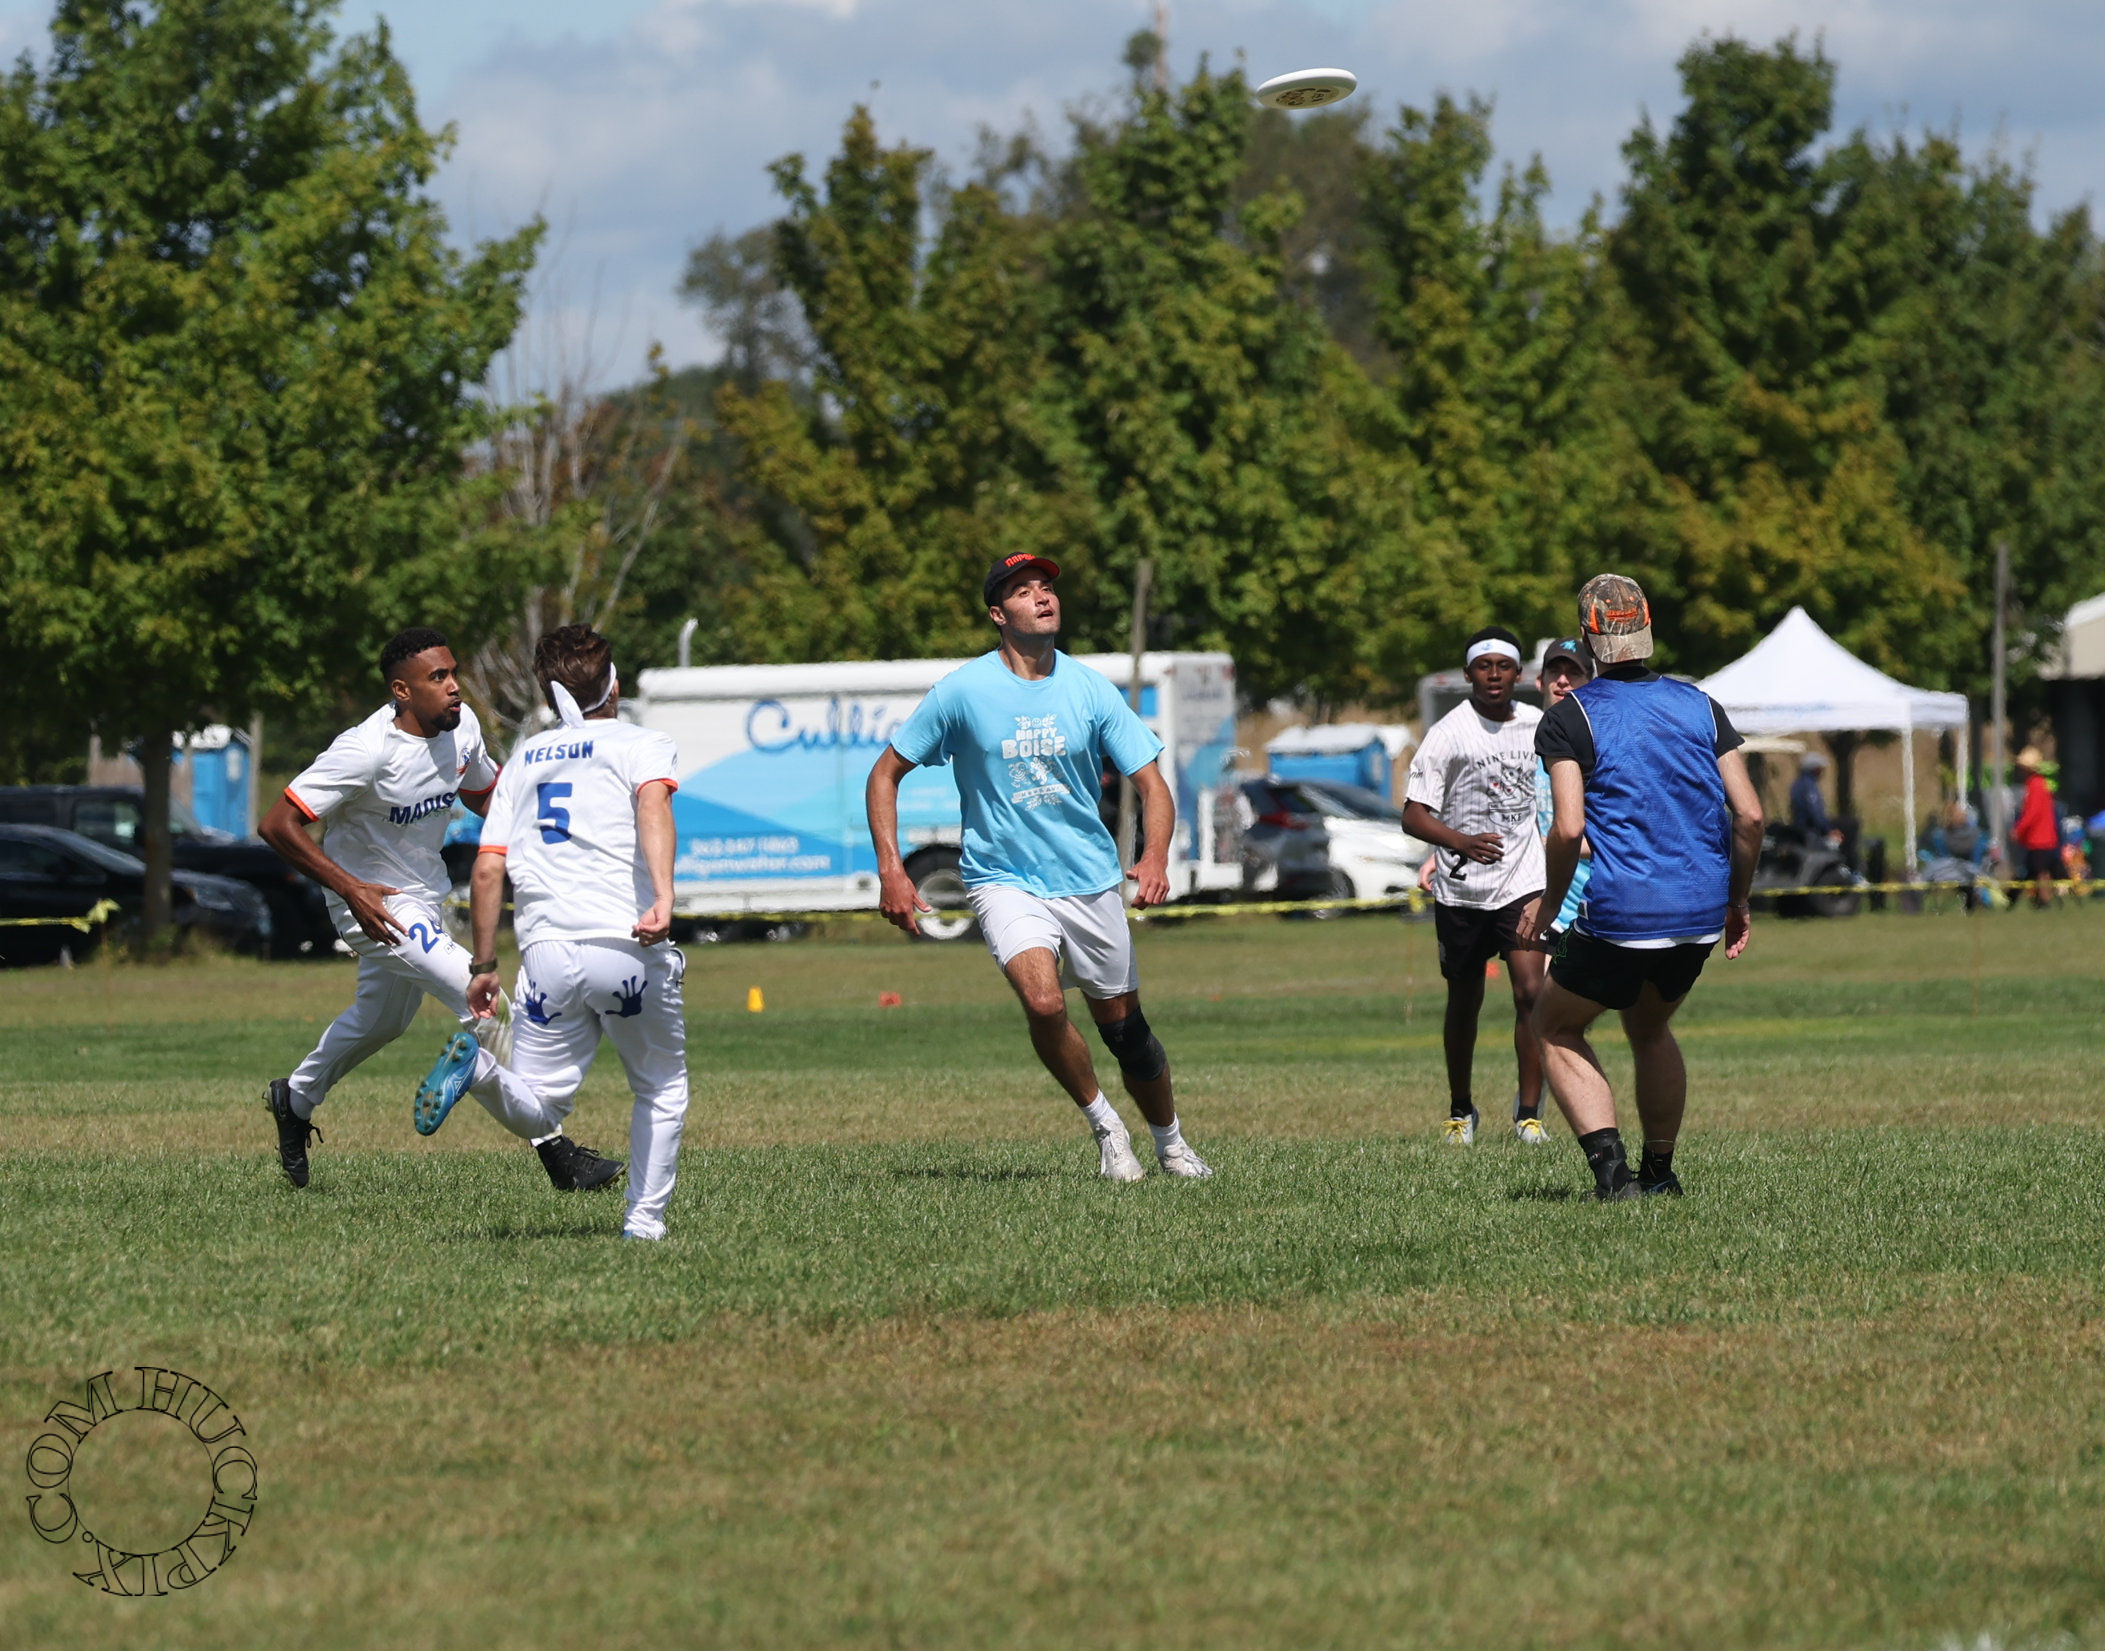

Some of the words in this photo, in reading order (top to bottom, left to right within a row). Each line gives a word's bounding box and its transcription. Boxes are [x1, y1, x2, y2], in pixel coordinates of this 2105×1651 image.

[1001, 735, 1066, 759] BOISE
[1015, 727, 1058, 741] HAPPY
[524, 740, 594, 766] NELSON
[1476, 751, 1506, 769] NINE
[389, 791, 460, 825] MADIS
[537, 782, 573, 845] 5
[1449, 849, 1469, 881] 2
